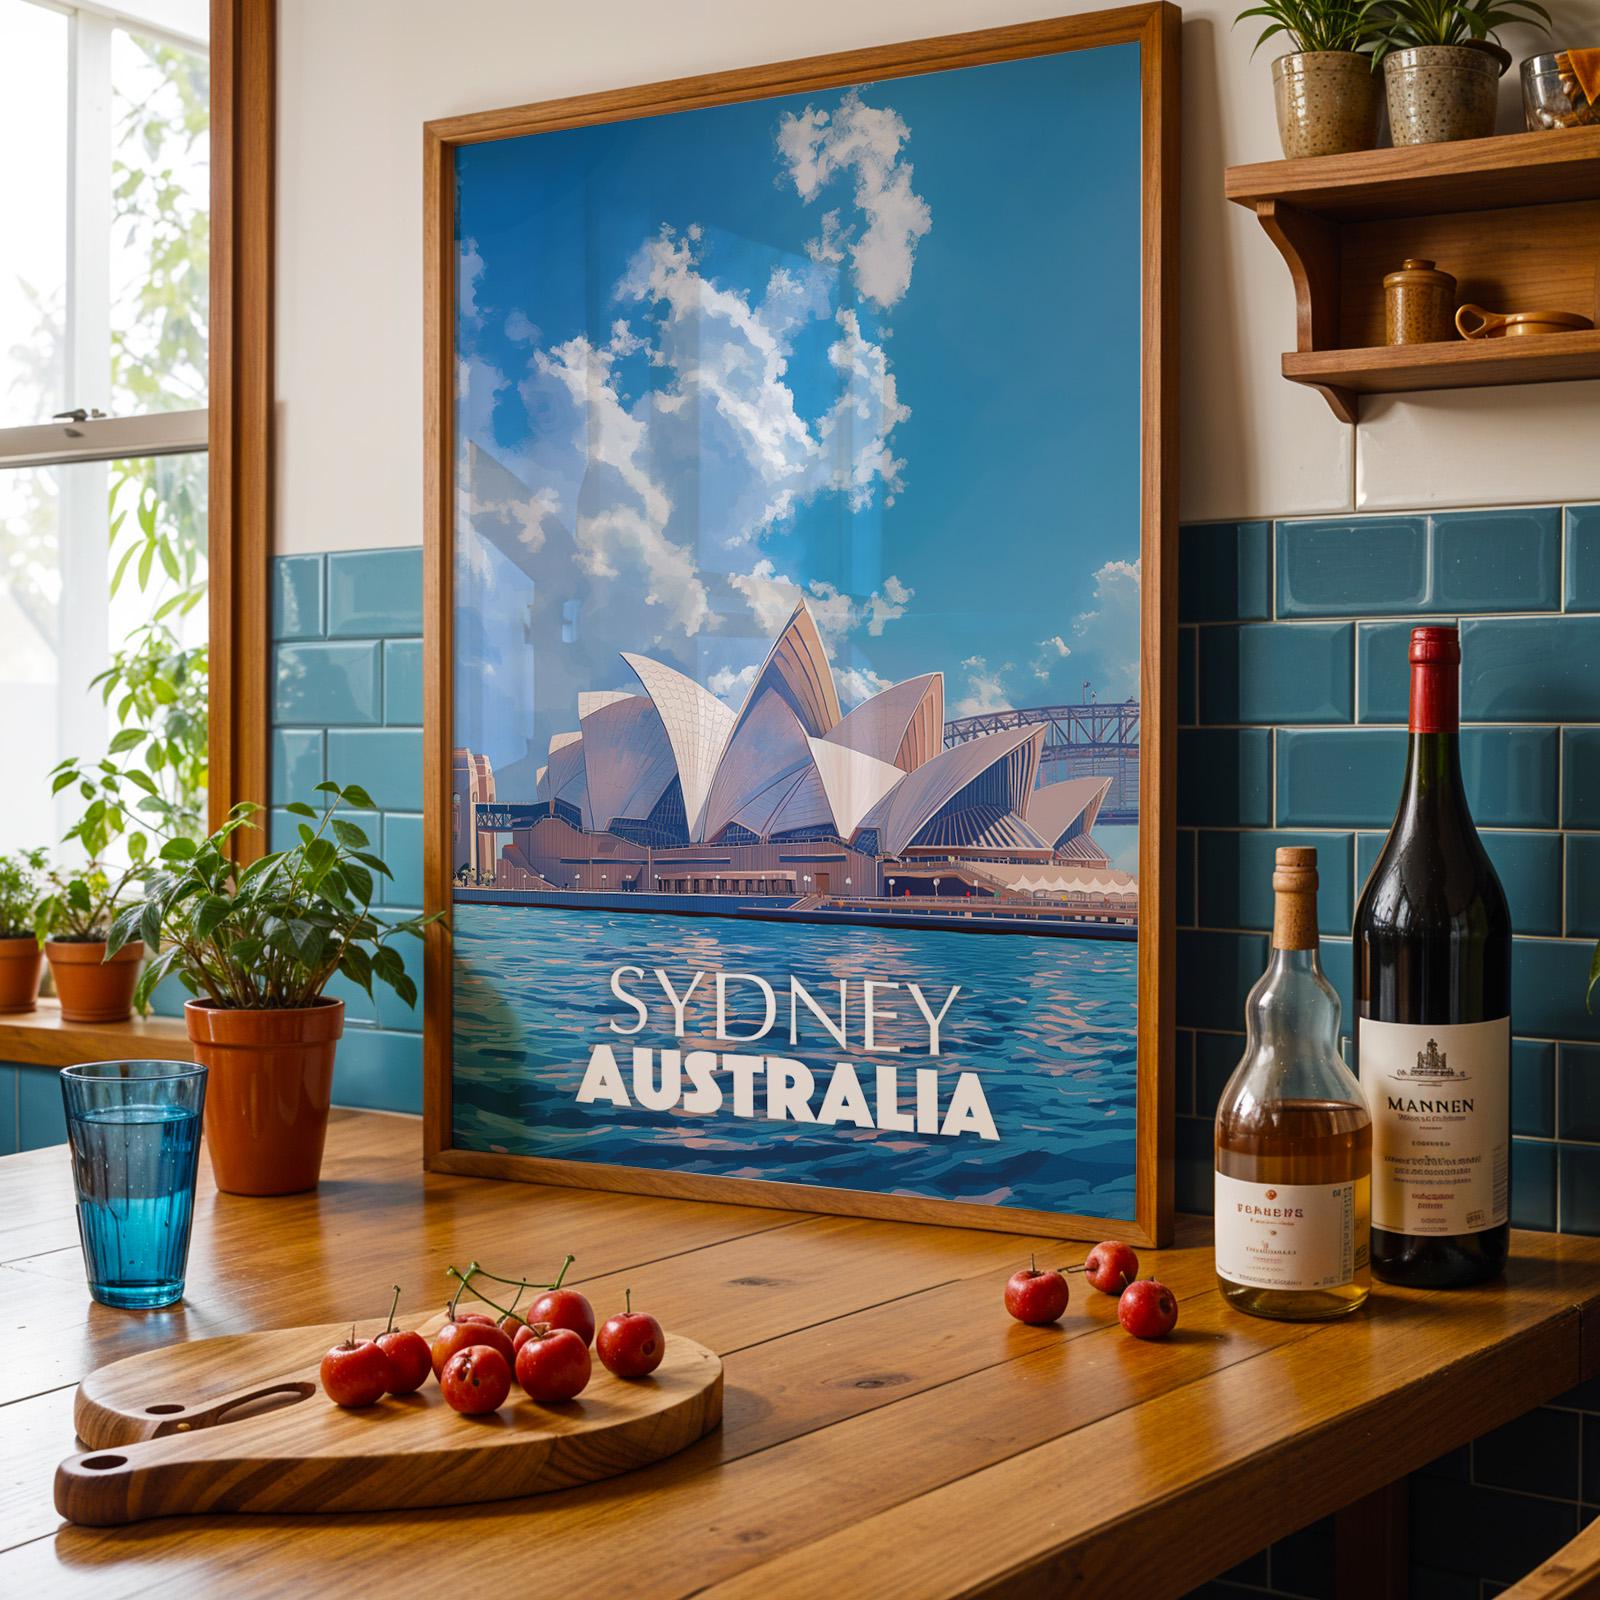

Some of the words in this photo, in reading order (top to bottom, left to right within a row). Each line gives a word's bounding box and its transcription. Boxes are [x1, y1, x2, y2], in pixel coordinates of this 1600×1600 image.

[609, 965, 962, 1056] SYDNEY
[575, 1044, 1000, 1141] AUSTRALIA
[1388, 1096, 1474, 1113] MANNEN
